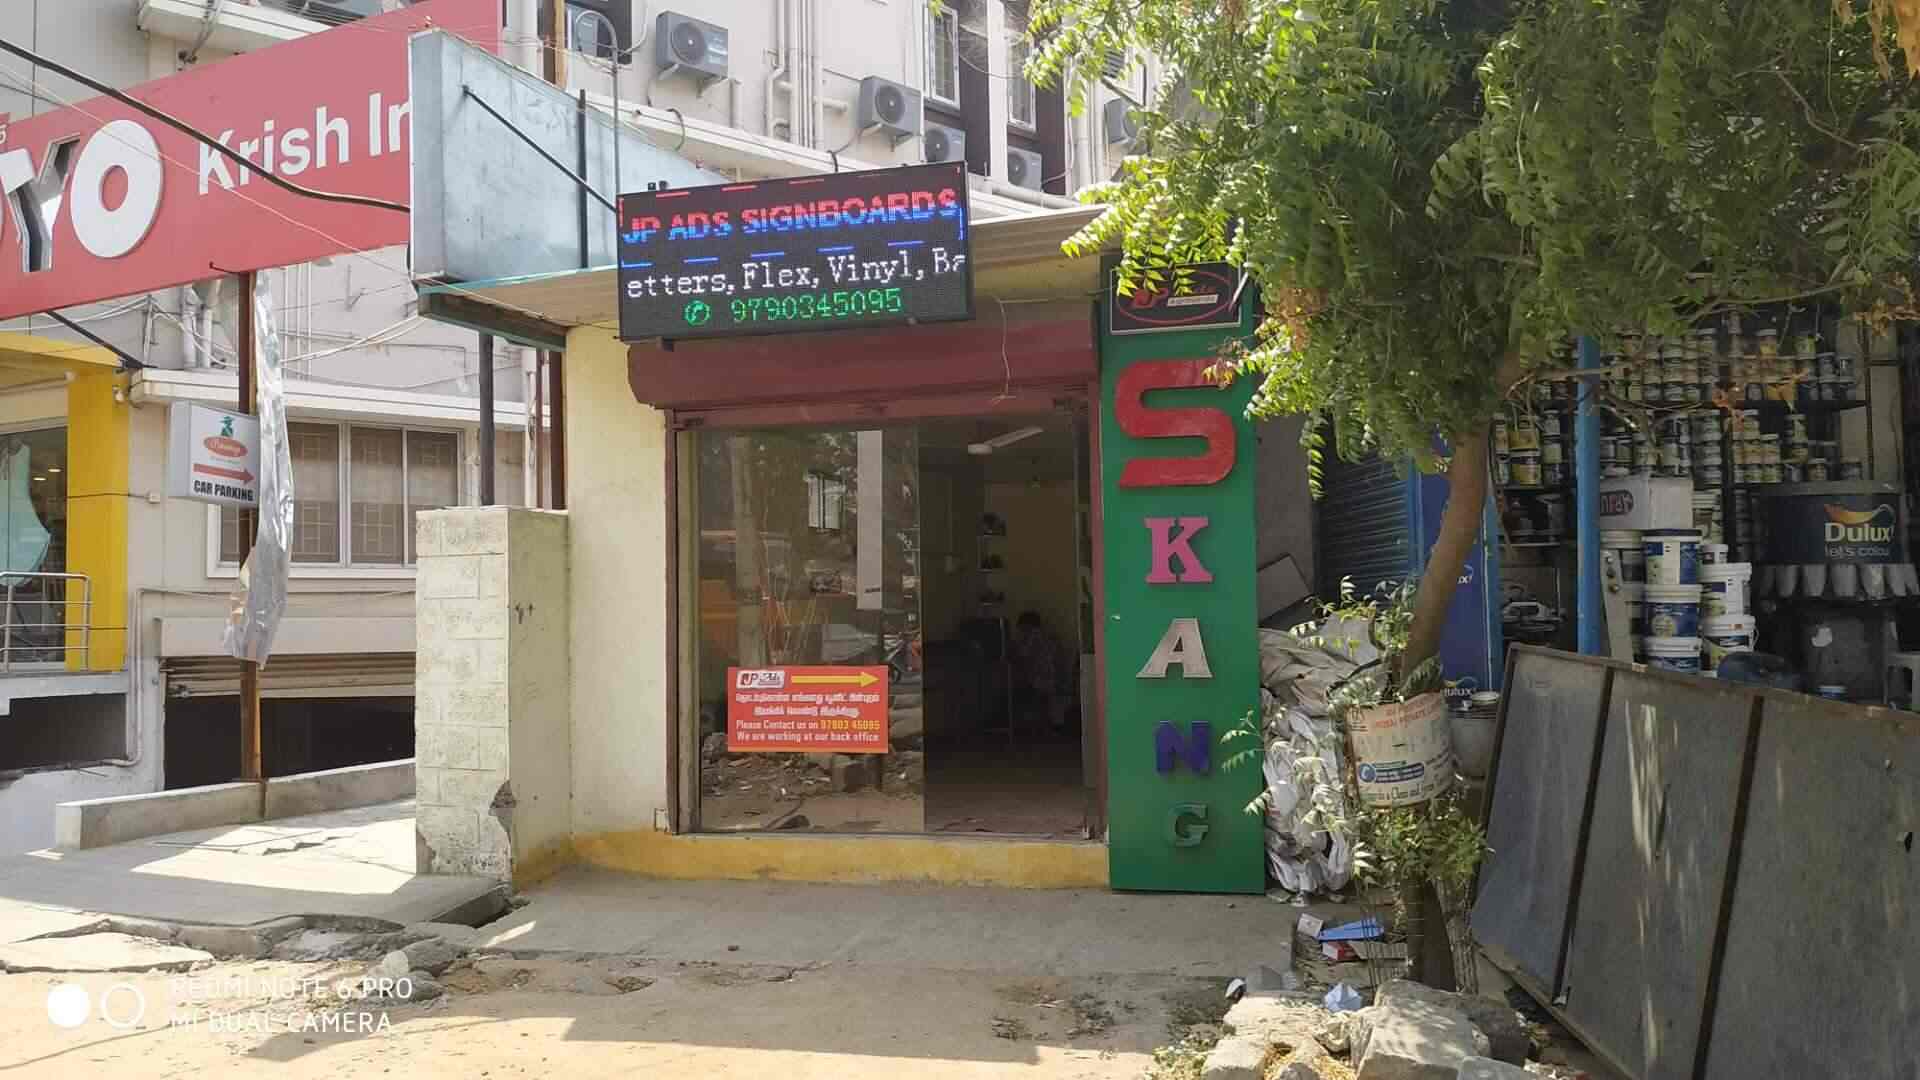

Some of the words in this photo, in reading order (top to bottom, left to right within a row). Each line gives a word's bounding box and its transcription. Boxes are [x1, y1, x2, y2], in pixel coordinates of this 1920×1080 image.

[199, 106, 349, 194] Krish
[0, 119, 163, 272] YO
[623, 216, 661, 244] JP
[668, 211, 733, 241] ADS
[741, 187, 958, 234] SIGNBOARDS
[730, 287, 902, 323] 9790345095
[193, 479, 213, 495] CAR
[214, 484, 254, 501] PARKING
[1824, 522, 1889, 542] Dulux
[736, 719, 762, 729] Please
[763, 719, 796, 729] Contact
[736, 731, 751, 741] We
[752, 733, 765, 741] are
[767, 731, 801, 743] working
[803, 732, 813, 741] at
[830, 731, 851, 741] back
